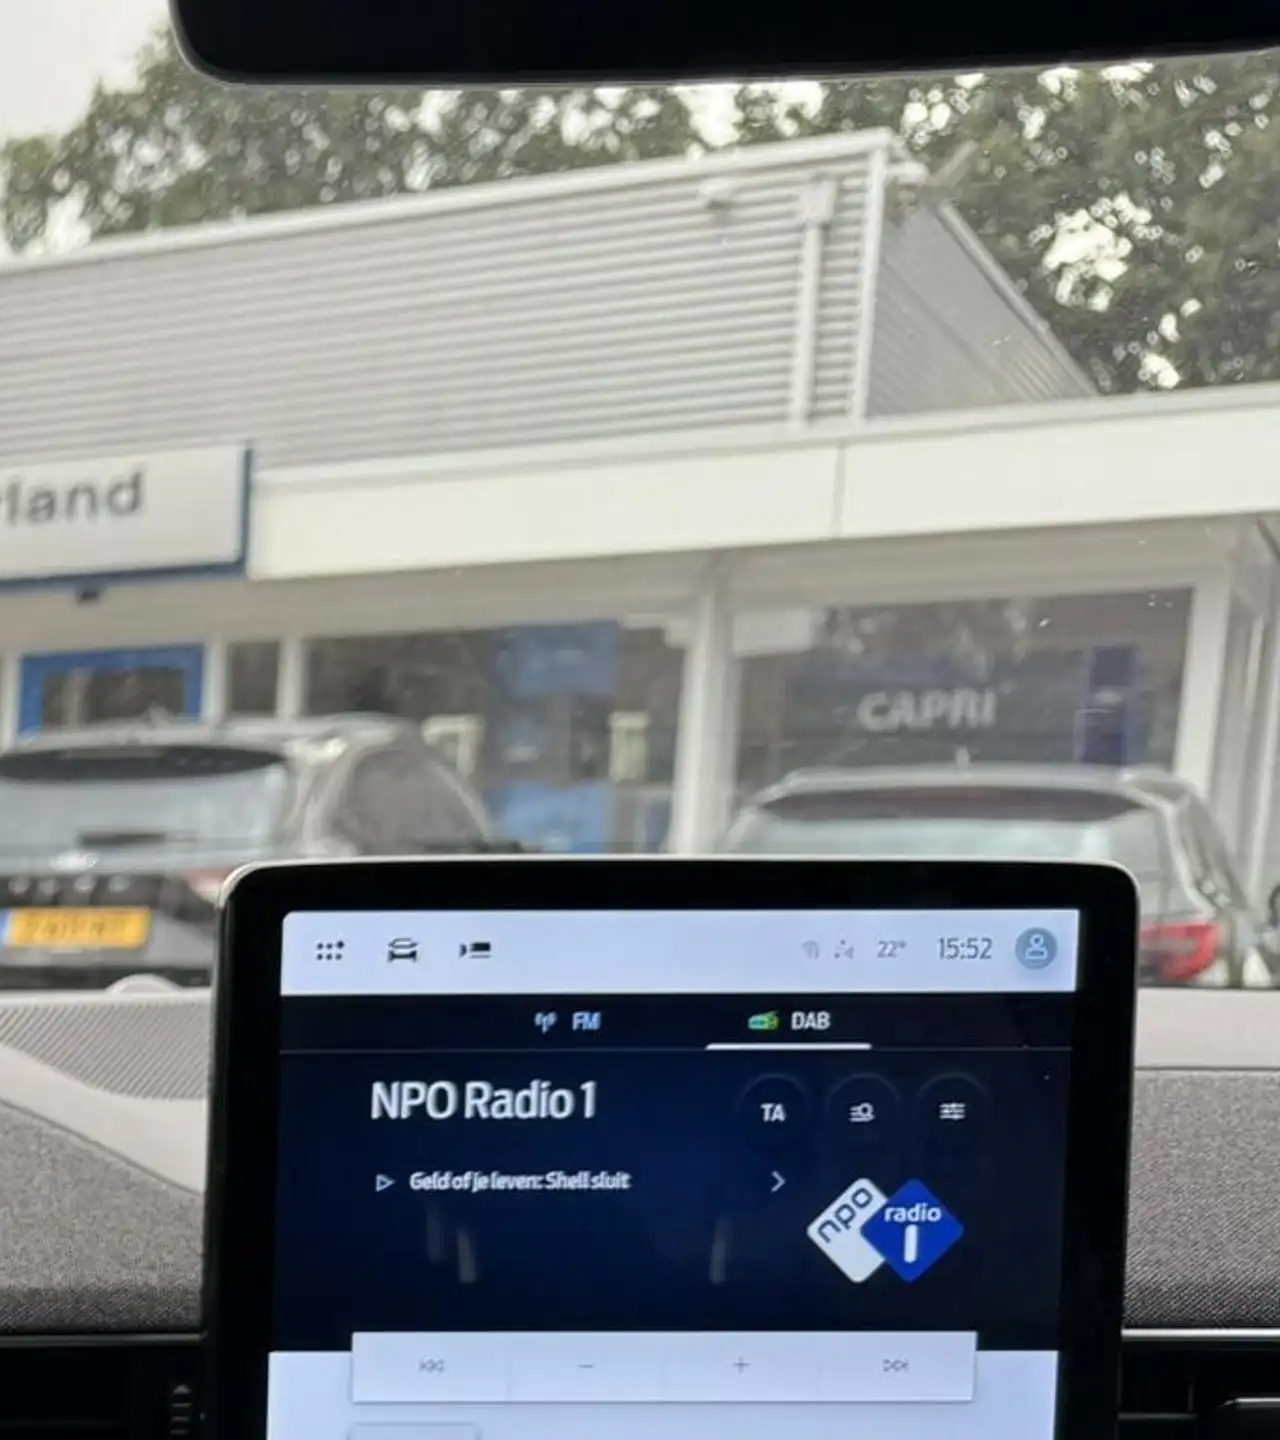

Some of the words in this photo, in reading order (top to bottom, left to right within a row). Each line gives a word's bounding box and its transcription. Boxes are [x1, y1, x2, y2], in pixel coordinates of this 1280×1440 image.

[856, 687, 996, 732] CAPRI
[937, 938, 993, 960] 15:52
[571, 1012, 602, 1031] FM
[790, 1012, 831, 1031] DAB
[370, 1079, 458, 1120] NPO
[463, 1078, 576, 1120] Radio
[580, 1079, 597, 1119] 1
[760, 1103, 787, 1122] TA
[408, 1171, 452, 1190] Geld
[452, 1171, 472, 1190] of
[471, 1172, 490, 1193] je
[491, 1171, 544, 1190] leven:
[544, 1171, 589, 1190] Shell
[591, 1171, 632, 1190] sluit
[816, 1187, 874, 1244] npo
[884, 1203, 942, 1223] radio
